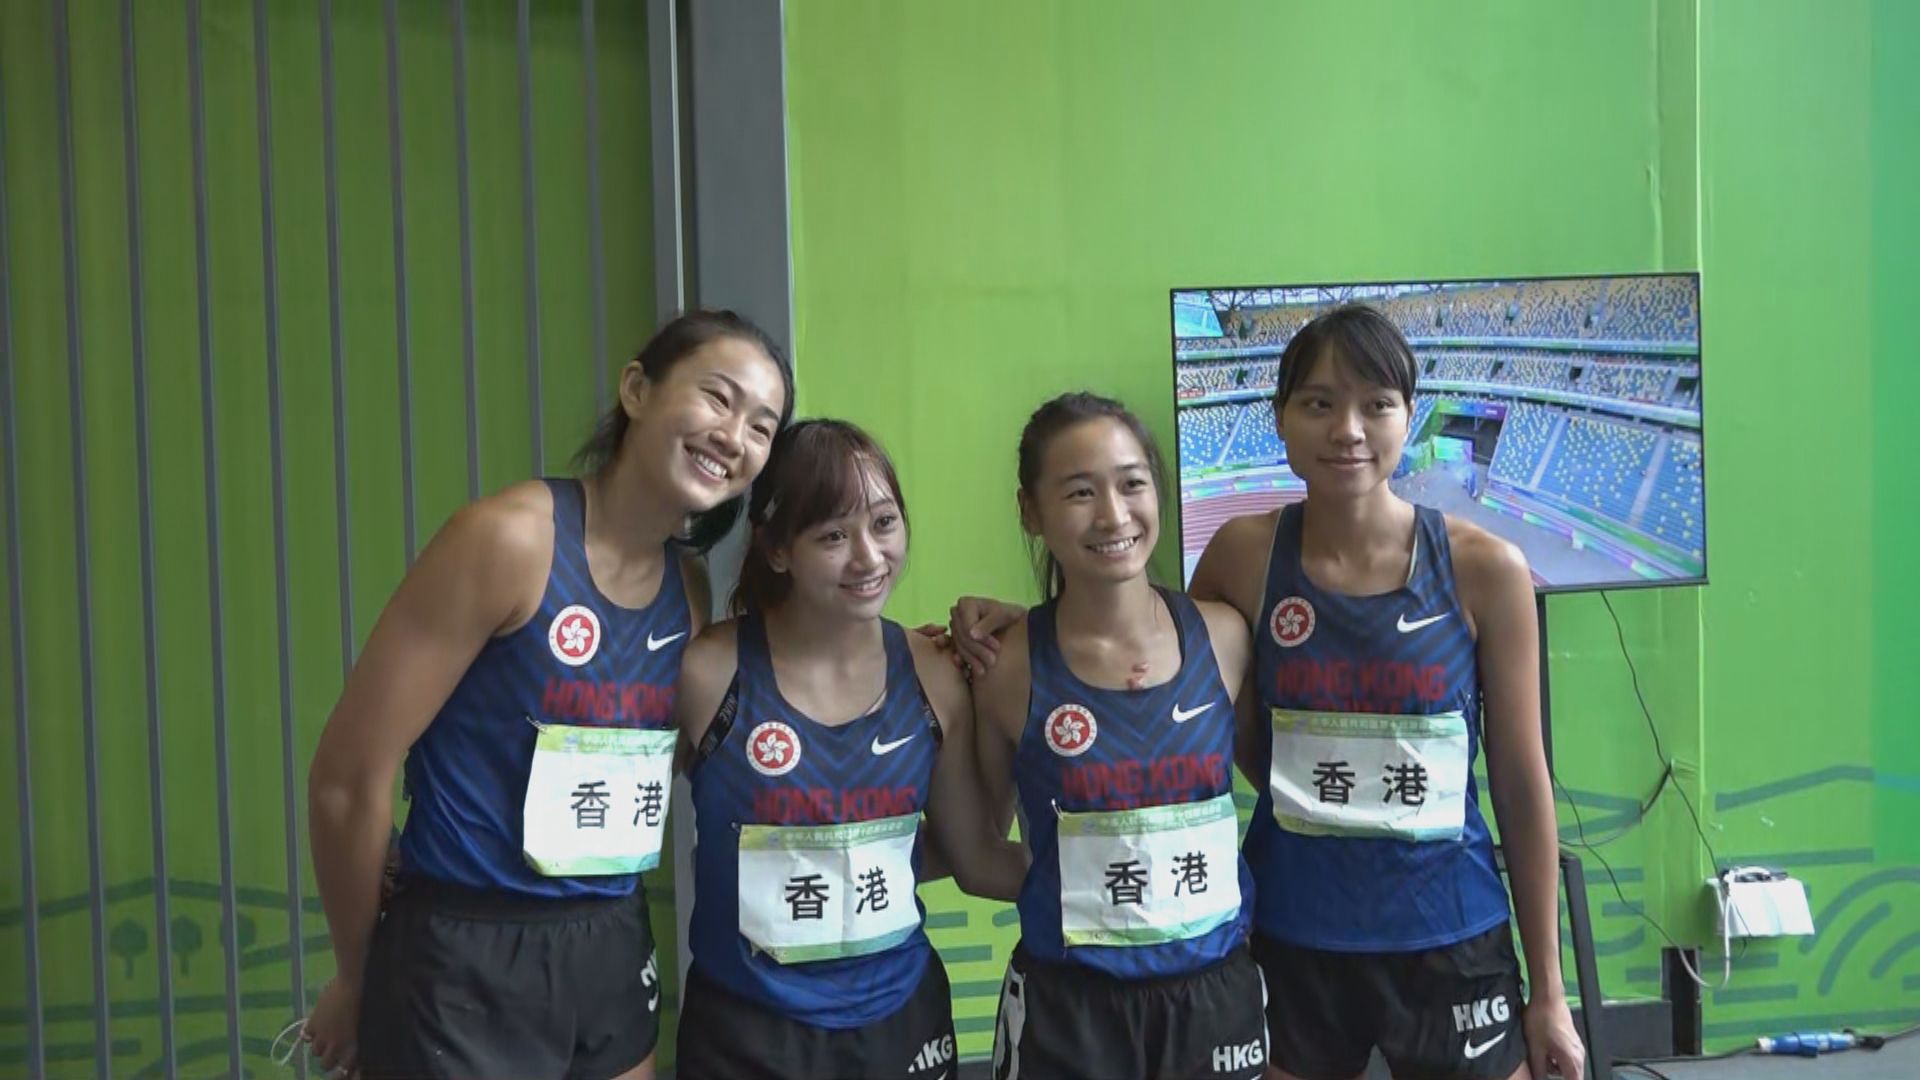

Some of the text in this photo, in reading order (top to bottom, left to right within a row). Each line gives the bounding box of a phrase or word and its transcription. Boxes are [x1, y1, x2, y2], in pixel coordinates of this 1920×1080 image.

[543, 676, 617, 720] HONG
[1276, 658, 1447, 700] HONG KONG
[1061, 752, 1224, 800] HONG KONG
[1313, 761, 1428, 807] 香港
[571, 780, 662, 829] 香港
[754, 784, 917, 824] HONG KONG
[785, 866, 888, 920] 香港
[1105, 851, 1208, 906] 香港
[1452, 994, 1510, 1033] HKG
[1213, 1039, 1263, 1072] HKG
